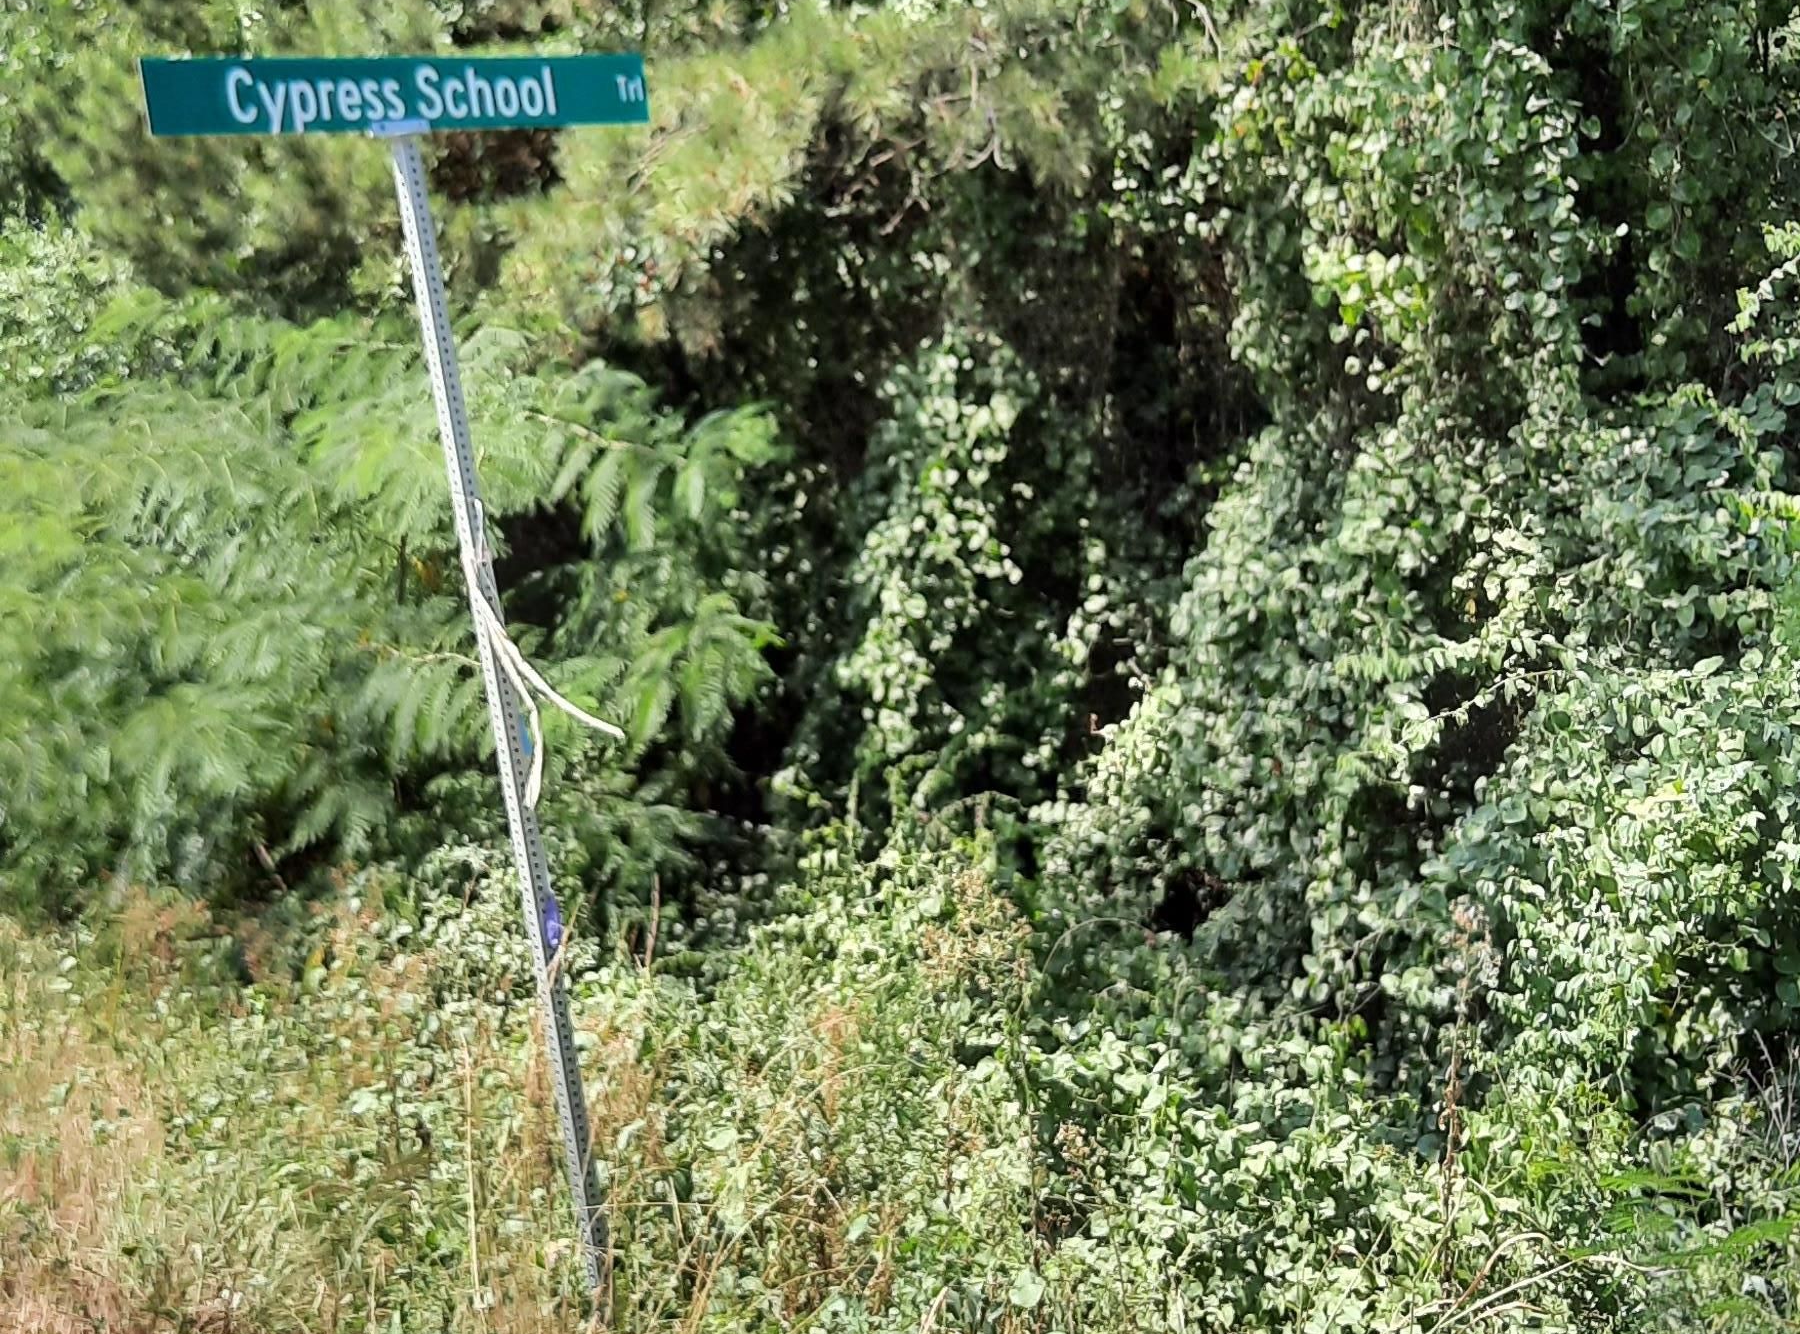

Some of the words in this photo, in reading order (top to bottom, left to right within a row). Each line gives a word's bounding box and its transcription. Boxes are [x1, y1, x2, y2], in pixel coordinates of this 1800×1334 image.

[225, 66, 406, 134] Cypress
[416, 66, 556, 119] School
[615, 74, 645, 102] Trl
